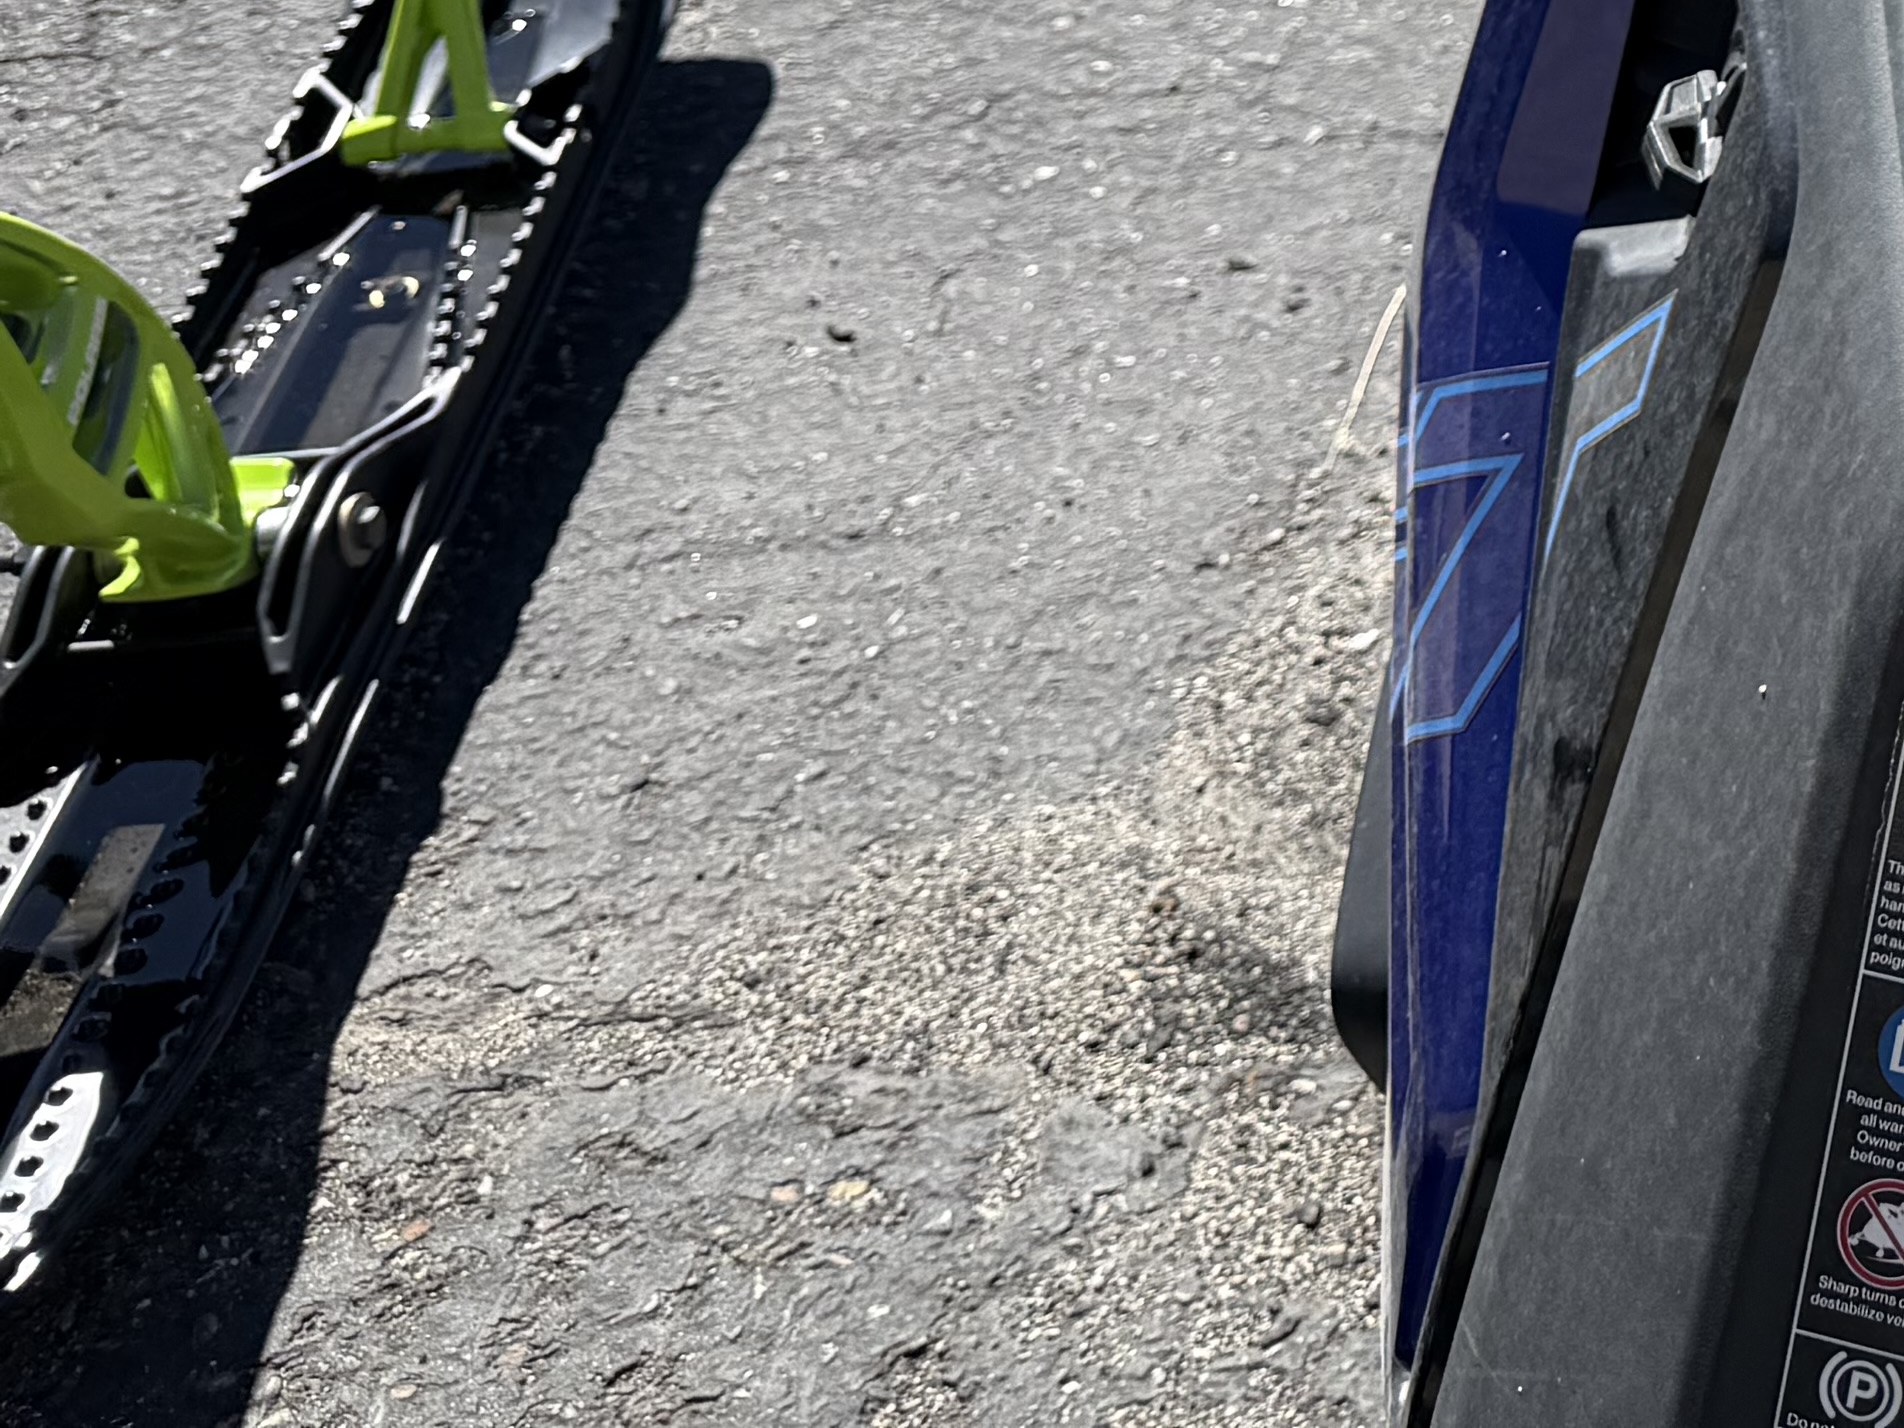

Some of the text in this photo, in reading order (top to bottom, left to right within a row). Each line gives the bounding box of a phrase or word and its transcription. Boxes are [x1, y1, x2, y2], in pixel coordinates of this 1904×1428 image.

[1883, 880, 1901, 894] as
[1873, 933, 1888, 947] et
[1845, 1089, 1884, 1111] Read
[1860, 1113, 1878, 1128] all
[1849, 1146, 1895, 1169] before
[1818, 1274, 1860, 1299] Sharp
[1861, 1286, 1897, 1307] turns
[1810, 1292, 1885, 1322] destabilize
